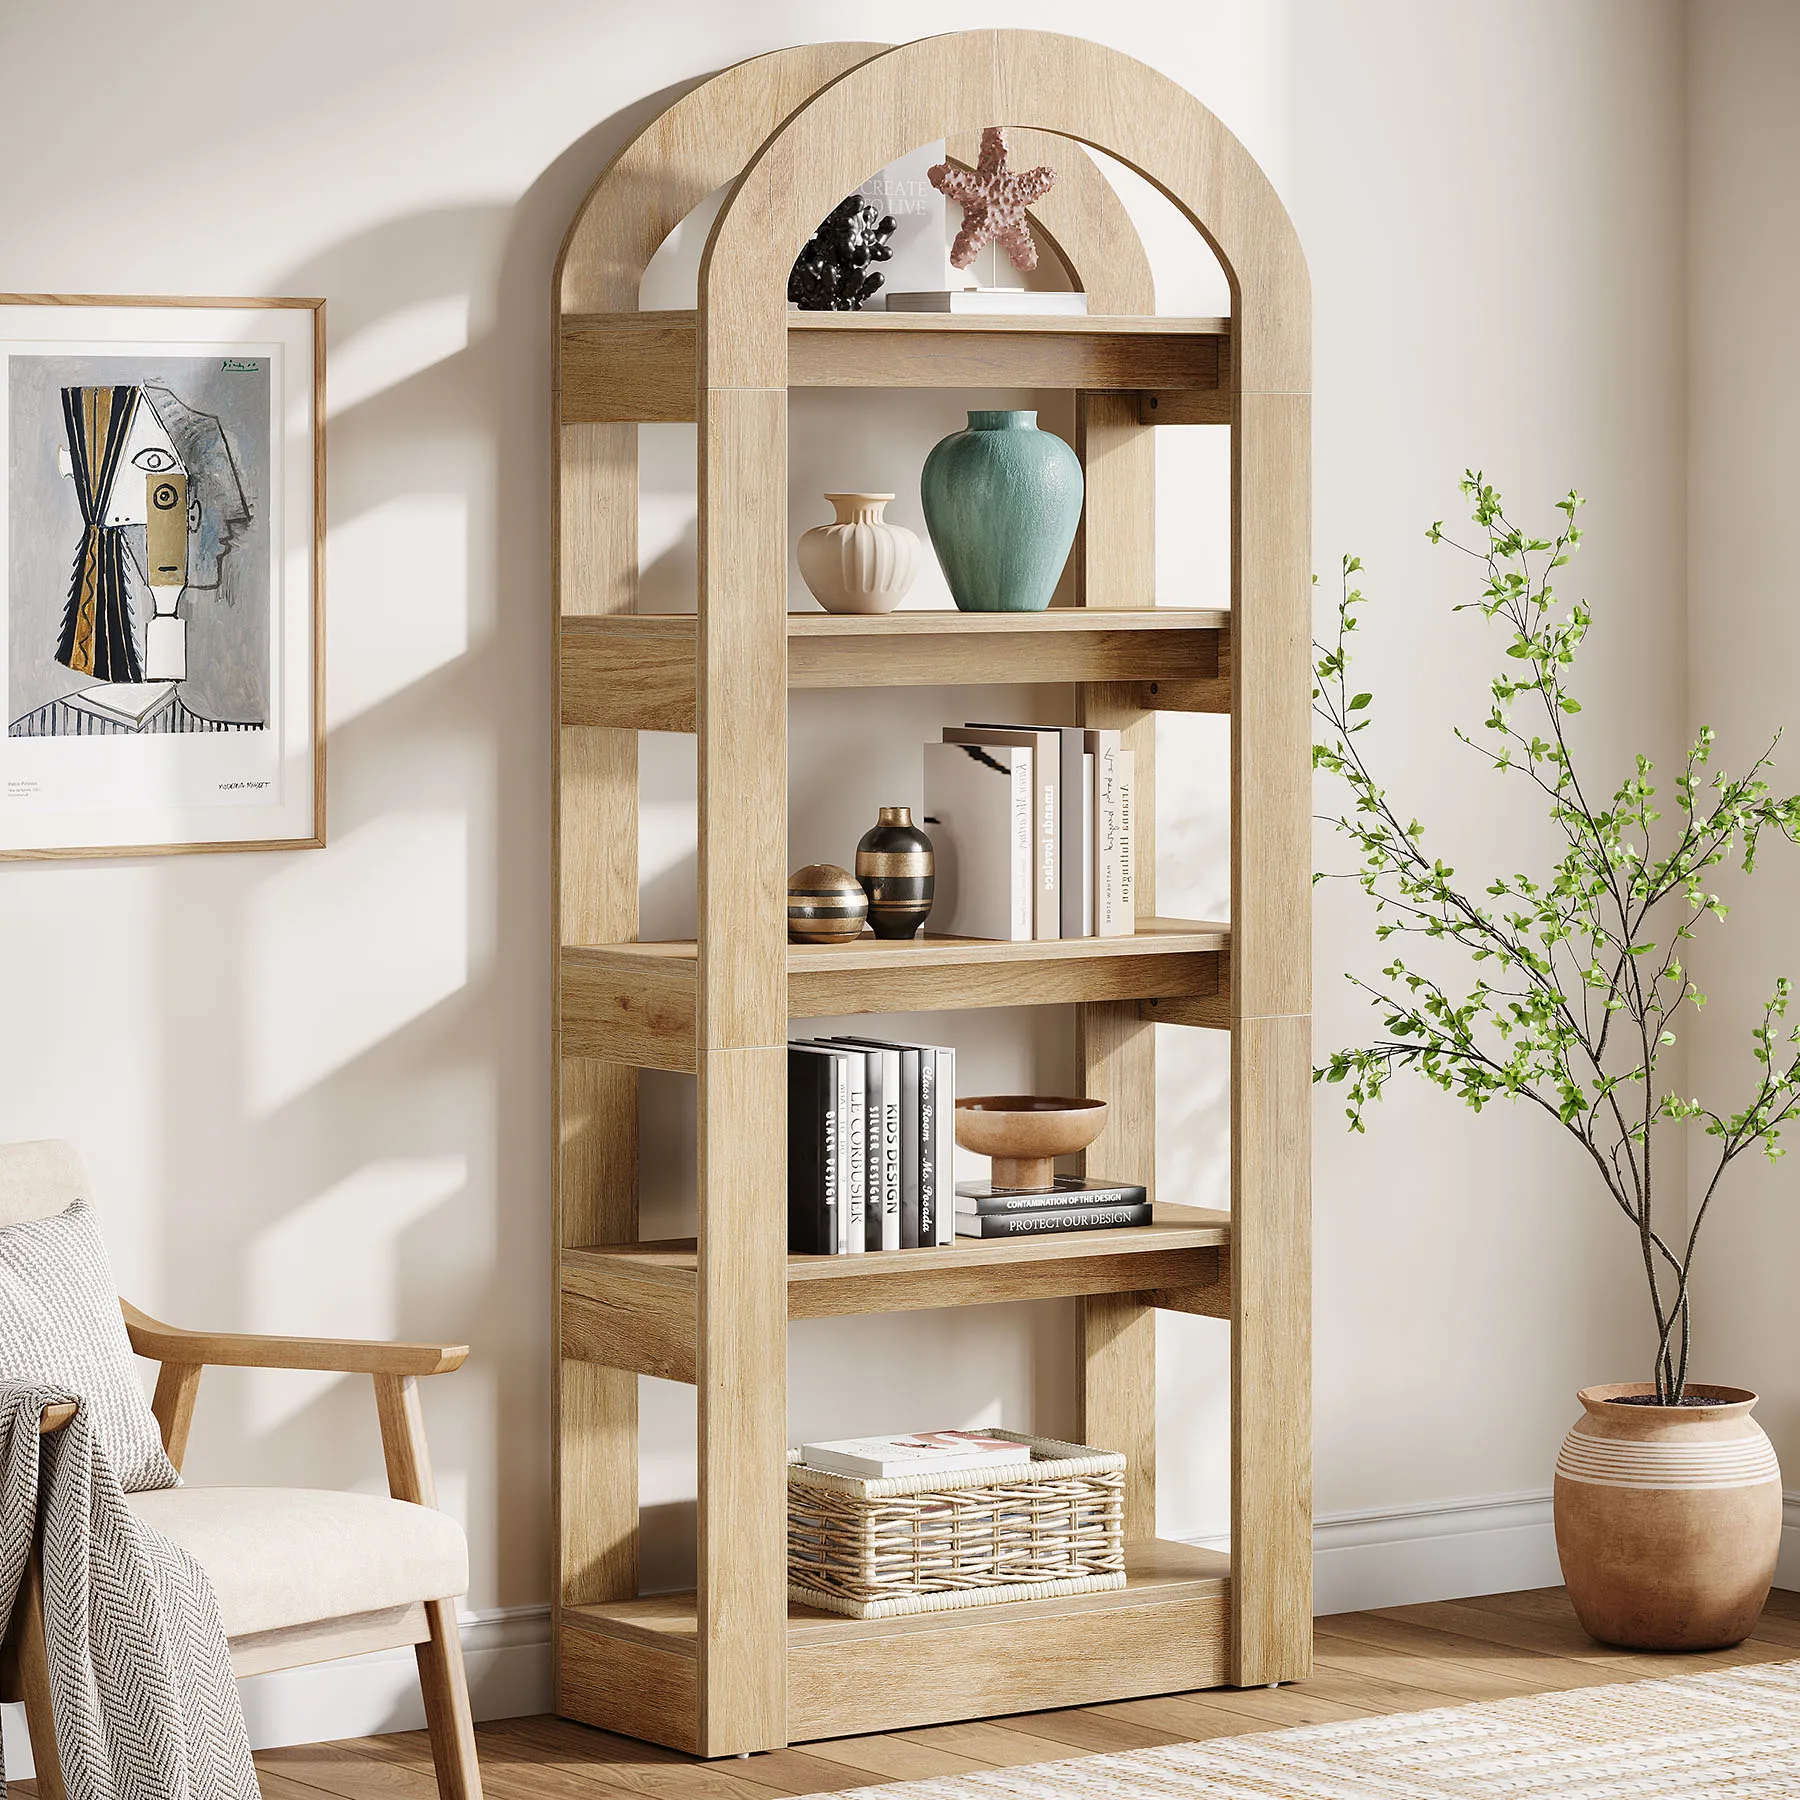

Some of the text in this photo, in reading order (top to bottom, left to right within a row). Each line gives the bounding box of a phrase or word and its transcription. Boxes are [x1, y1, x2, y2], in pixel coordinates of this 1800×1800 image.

[861, 180, 928, 197] CREATE
[887, 199, 927, 216] LIVE
[921, 1066, 933, 1101] Class
[922, 1106, 933, 1142] Room
[825, 1111, 836, 1206] BLACK DESIGN
[850, 1091, 864, 1224] LE CORBUSIER
[869, 1105, 880, 1203] SILVER DESIGN
[886, 1104, 898, 1214] KIDS DESIGN
[921, 1186, 932, 1233] Posada
[1006, 1193, 1122, 1209] CONTAMINATION OF THE DESIGN
[1009, 1212, 1132, 1232] PROTECT OUR DESIGN
